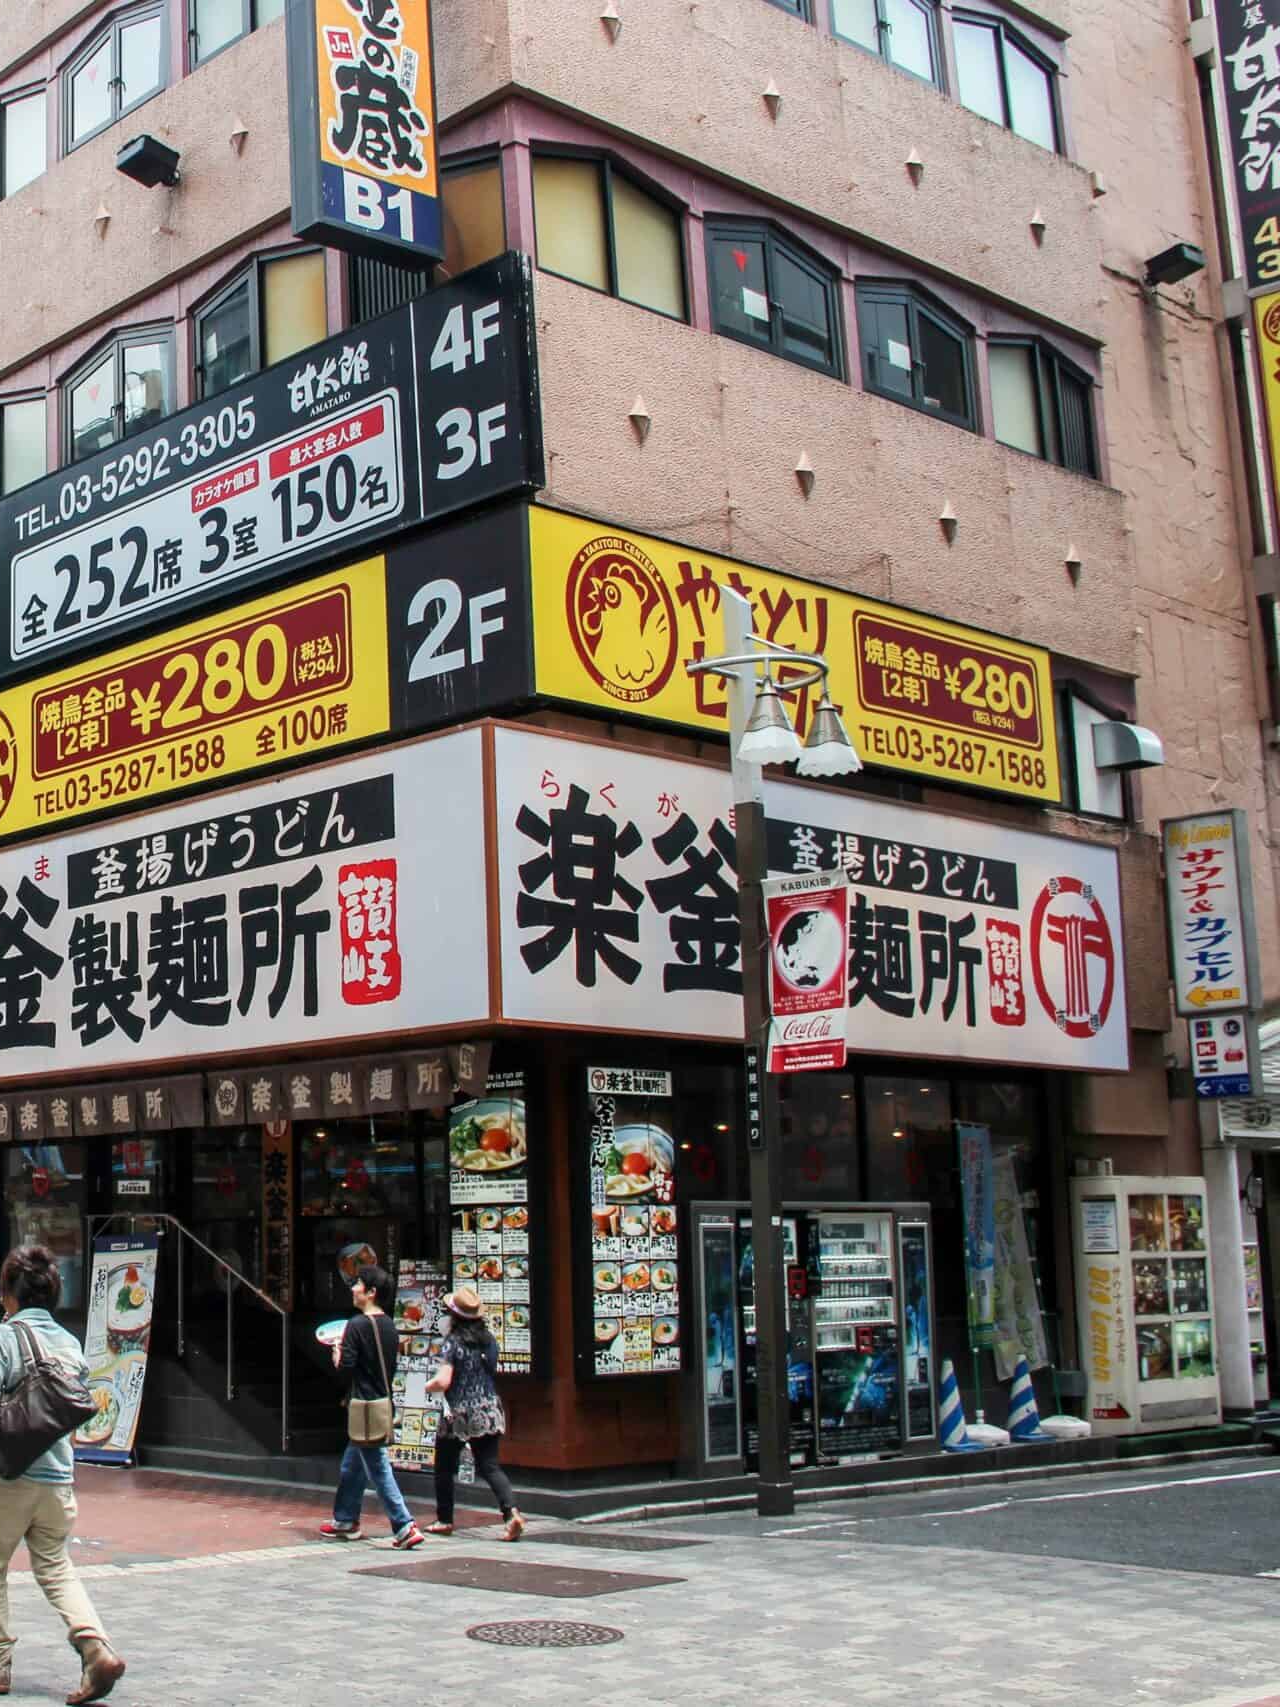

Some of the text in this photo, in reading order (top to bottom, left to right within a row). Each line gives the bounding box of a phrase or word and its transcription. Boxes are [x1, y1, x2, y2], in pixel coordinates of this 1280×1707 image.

[342, 167, 415, 243] B1
[429, 300, 501, 374] 4F
[286, 341, 370, 414] 甘太郎
[310, 391, 352, 418] AMATARO
[289, 420, 363, 467] 最大宴会人数
[434, 403, 508, 481] 3F
[194, 468, 257, 508] カラオケ個室
[271, 453, 390, 544] 150名
[198, 506, 259, 575] 3室
[583, 537, 657, 576] YAKITORI CENTER
[20, 524, 183, 644] 全252席
[406, 576, 508, 684] 2F
[864, 635, 941, 681] 焼鳥全品
[38, 679, 127, 736] 焼鳥全品
[130, 623, 288, 736] ¥280
[602, 679, 649, 702] SINCE 2012
[943, 657, 1034, 720] ¥280
[254, 702, 349, 758] 全100席
[858, 724, 1047, 790] TEL03-5287-1588
[33, 734, 226, 818] TEL03-5287-1588
[92, 790, 357, 900] 釜揚げうどん
[788, 826, 998, 906] 釜揚げうどん
[515, 782, 984, 1029] 楽釜麺所
[1176, 848, 1234, 985] サウナ&カプセル
[19, 1087, 163, 1132] 楽釜製麺所
[251, 1058, 444, 1115] 楽釜製麺所
